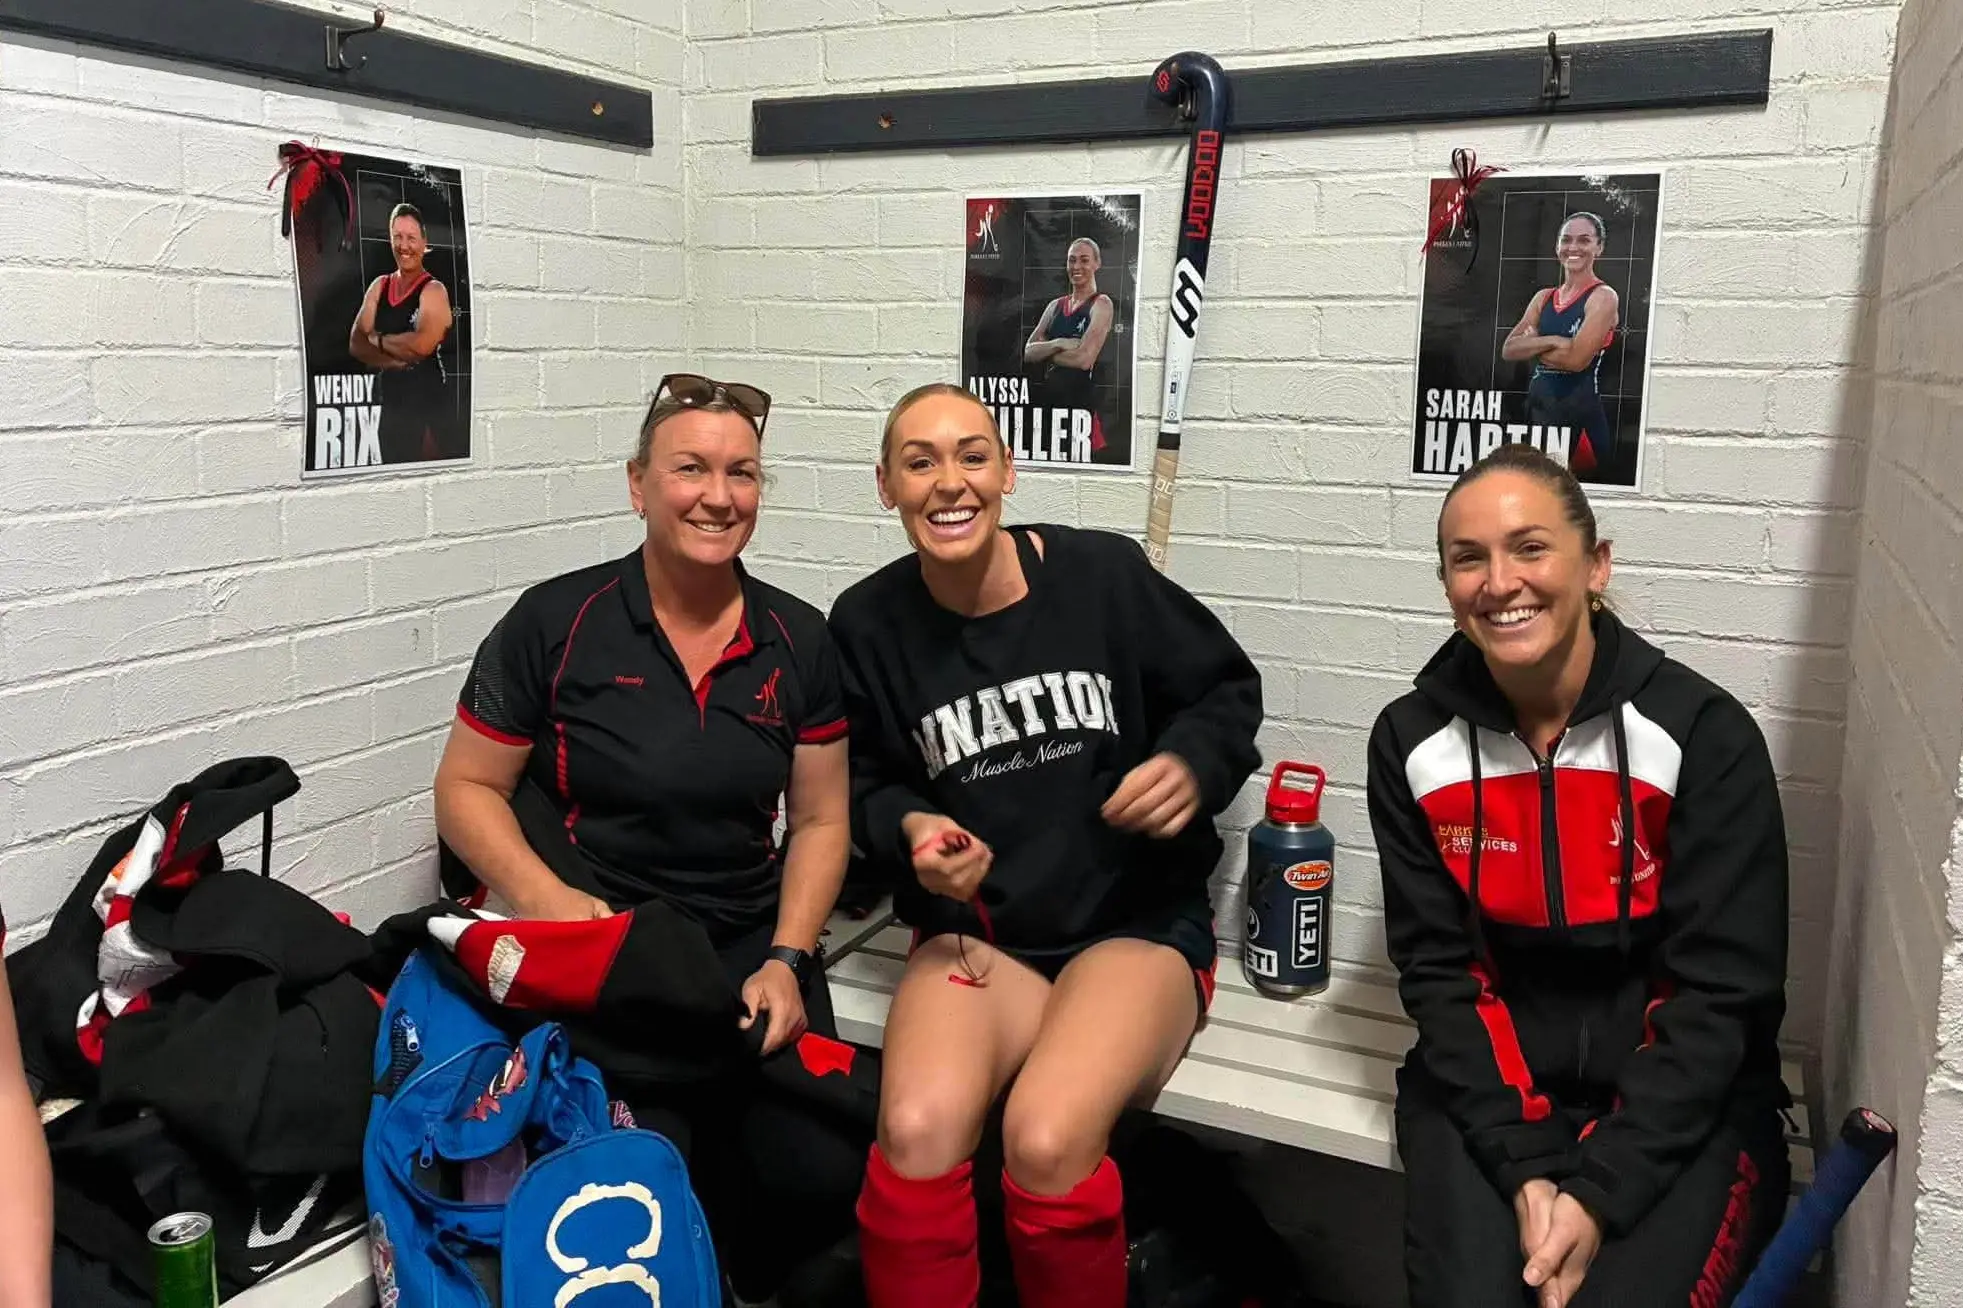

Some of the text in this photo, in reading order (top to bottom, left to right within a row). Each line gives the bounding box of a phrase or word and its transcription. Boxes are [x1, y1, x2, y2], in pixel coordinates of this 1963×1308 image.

[1186, 130, 1219, 239] VOODOO
[314, 374, 375, 404] WENDY
[968, 376, 1030, 405] ALYSSA
[1426, 388, 1502, 421] SARAH
[314, 405, 383, 470] RIX
[985, 405, 1092, 463] ILLER
[961, 739, 1084, 783] Muscle Nation
[1291, 871, 1317, 881] Twin
[1299, 904, 1318, 963] YETI
[1246, 946, 1273, 973] ETI
